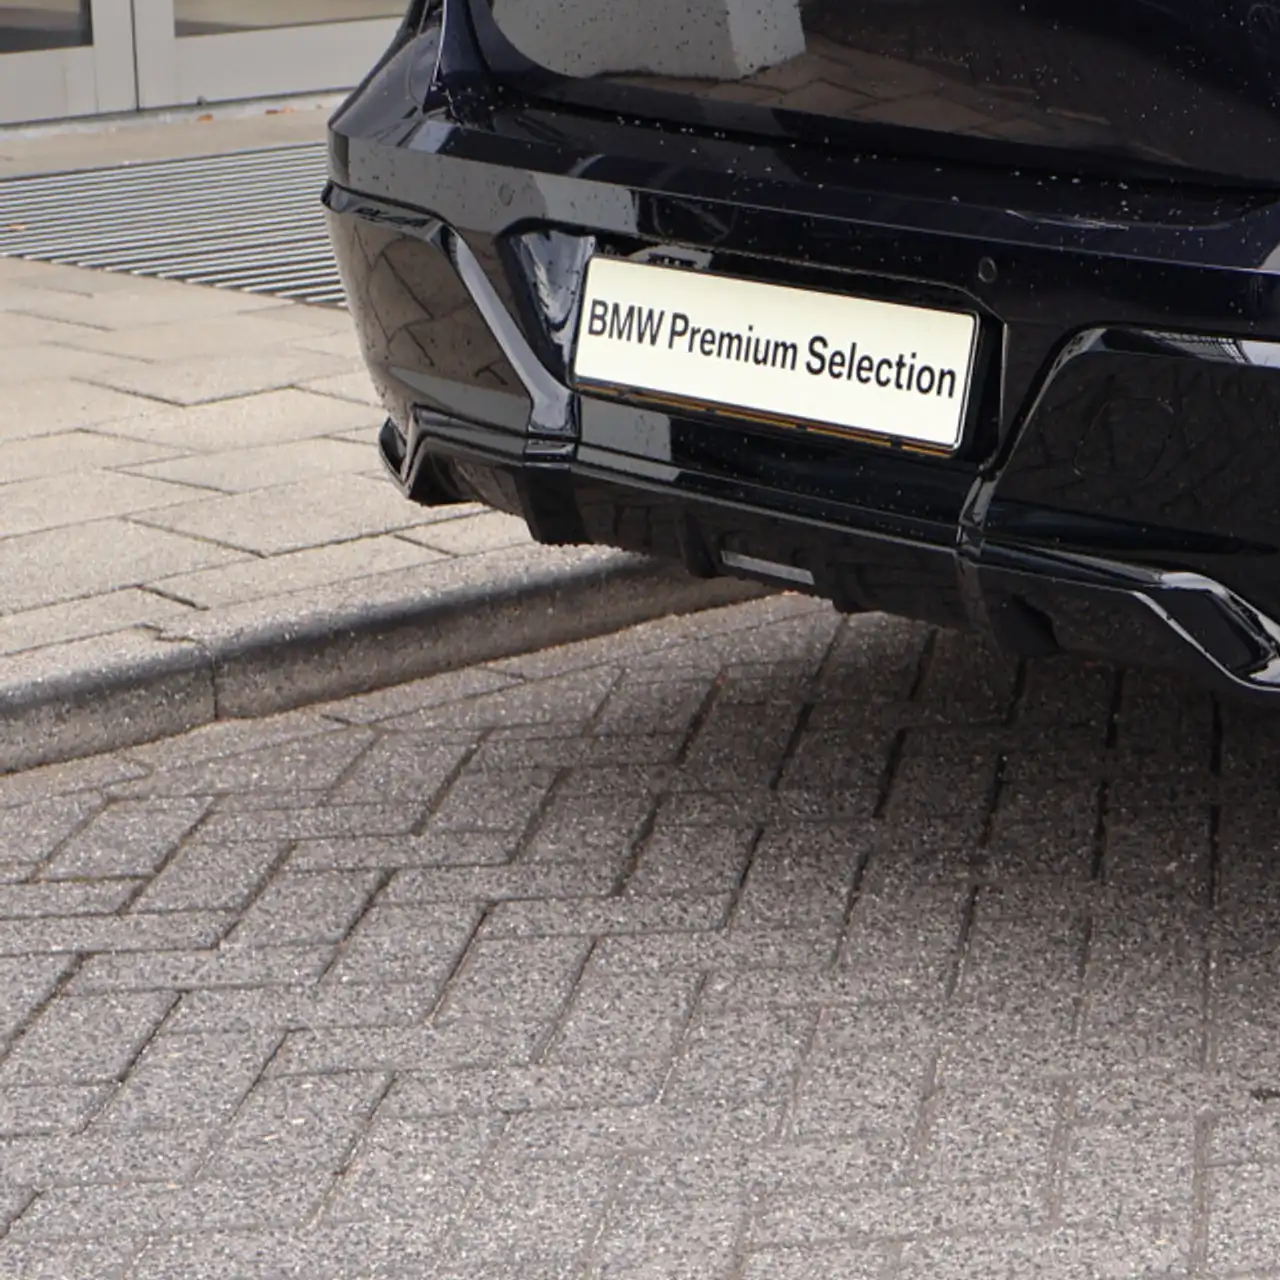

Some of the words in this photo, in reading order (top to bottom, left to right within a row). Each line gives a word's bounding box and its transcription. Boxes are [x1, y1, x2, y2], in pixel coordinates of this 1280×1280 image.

[587, 298, 666, 348] BMW
[667, 311, 799, 371] Premium
[804, 334, 958, 400] Selection
